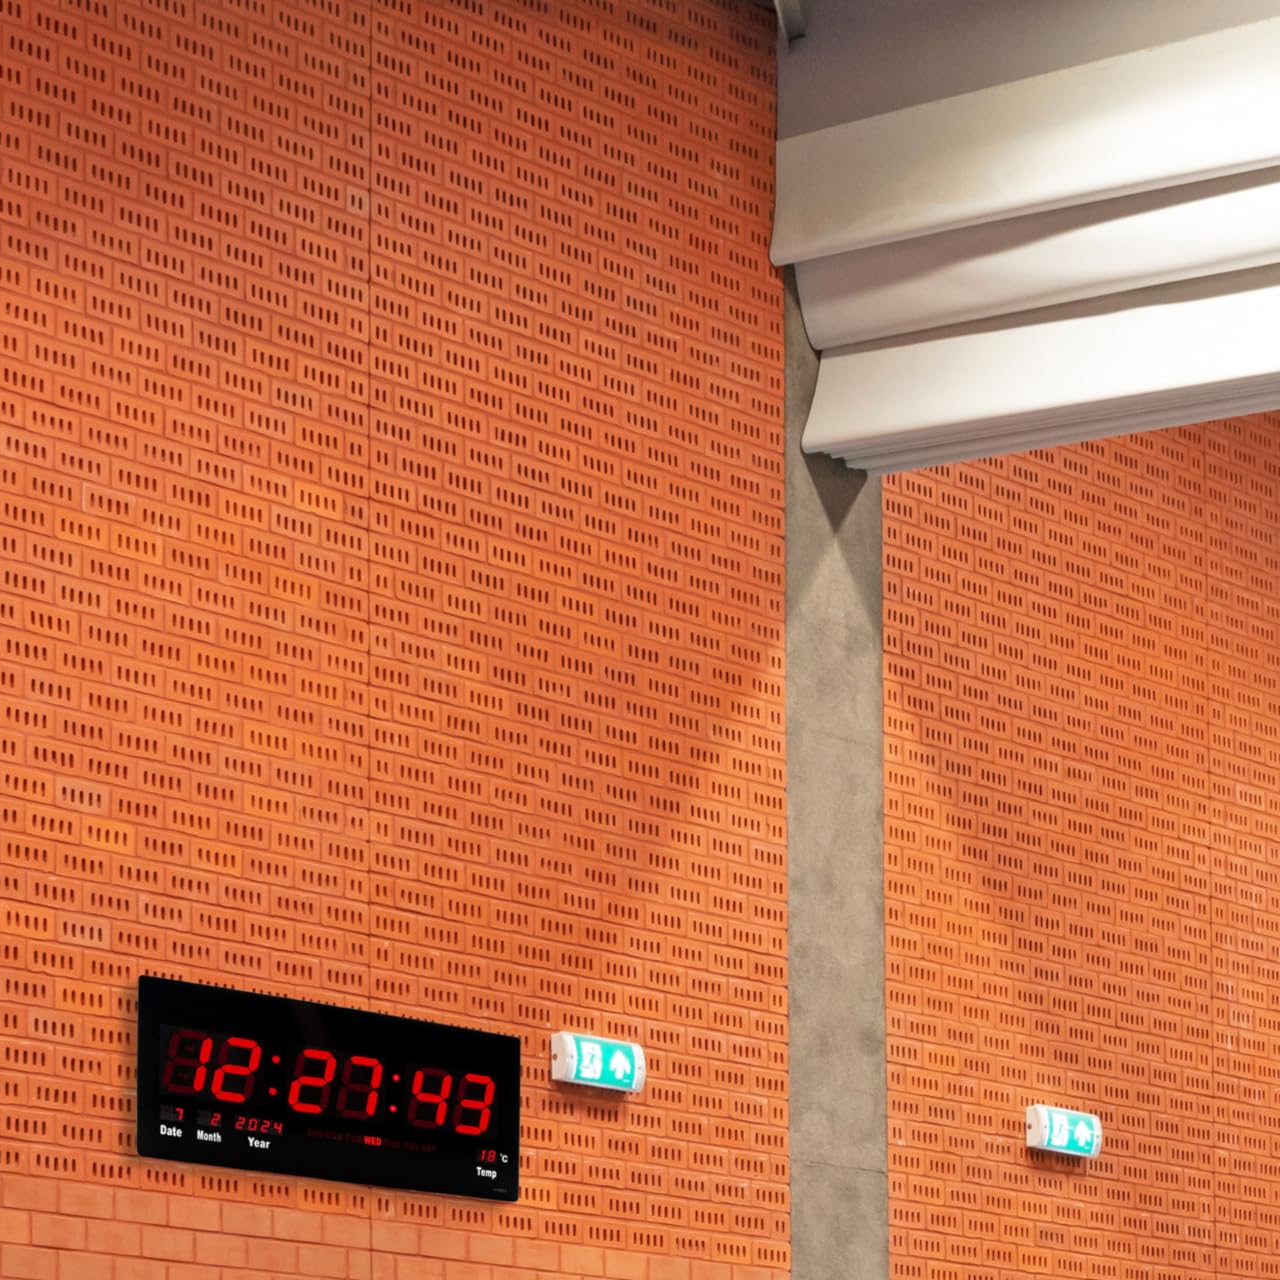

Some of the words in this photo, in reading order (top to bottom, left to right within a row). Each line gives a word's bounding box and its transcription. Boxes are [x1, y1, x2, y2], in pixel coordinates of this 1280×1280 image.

[192, 1036, 496, 1135] 12:27:43
[176, 1108, 184, 1120] 7
[210, 1113, 221, 1127] 2
[160, 1124, 182, 1137] Date
[235, 1117, 283, 1134] 2024
[197, 1129, 222, 1143] Month
[248, 1136, 271, 1149] Year
[363, 1135, 382, 1147] WED
[481, 1150, 497, 1163] 18
[476, 1166, 497, 1180] Temp
